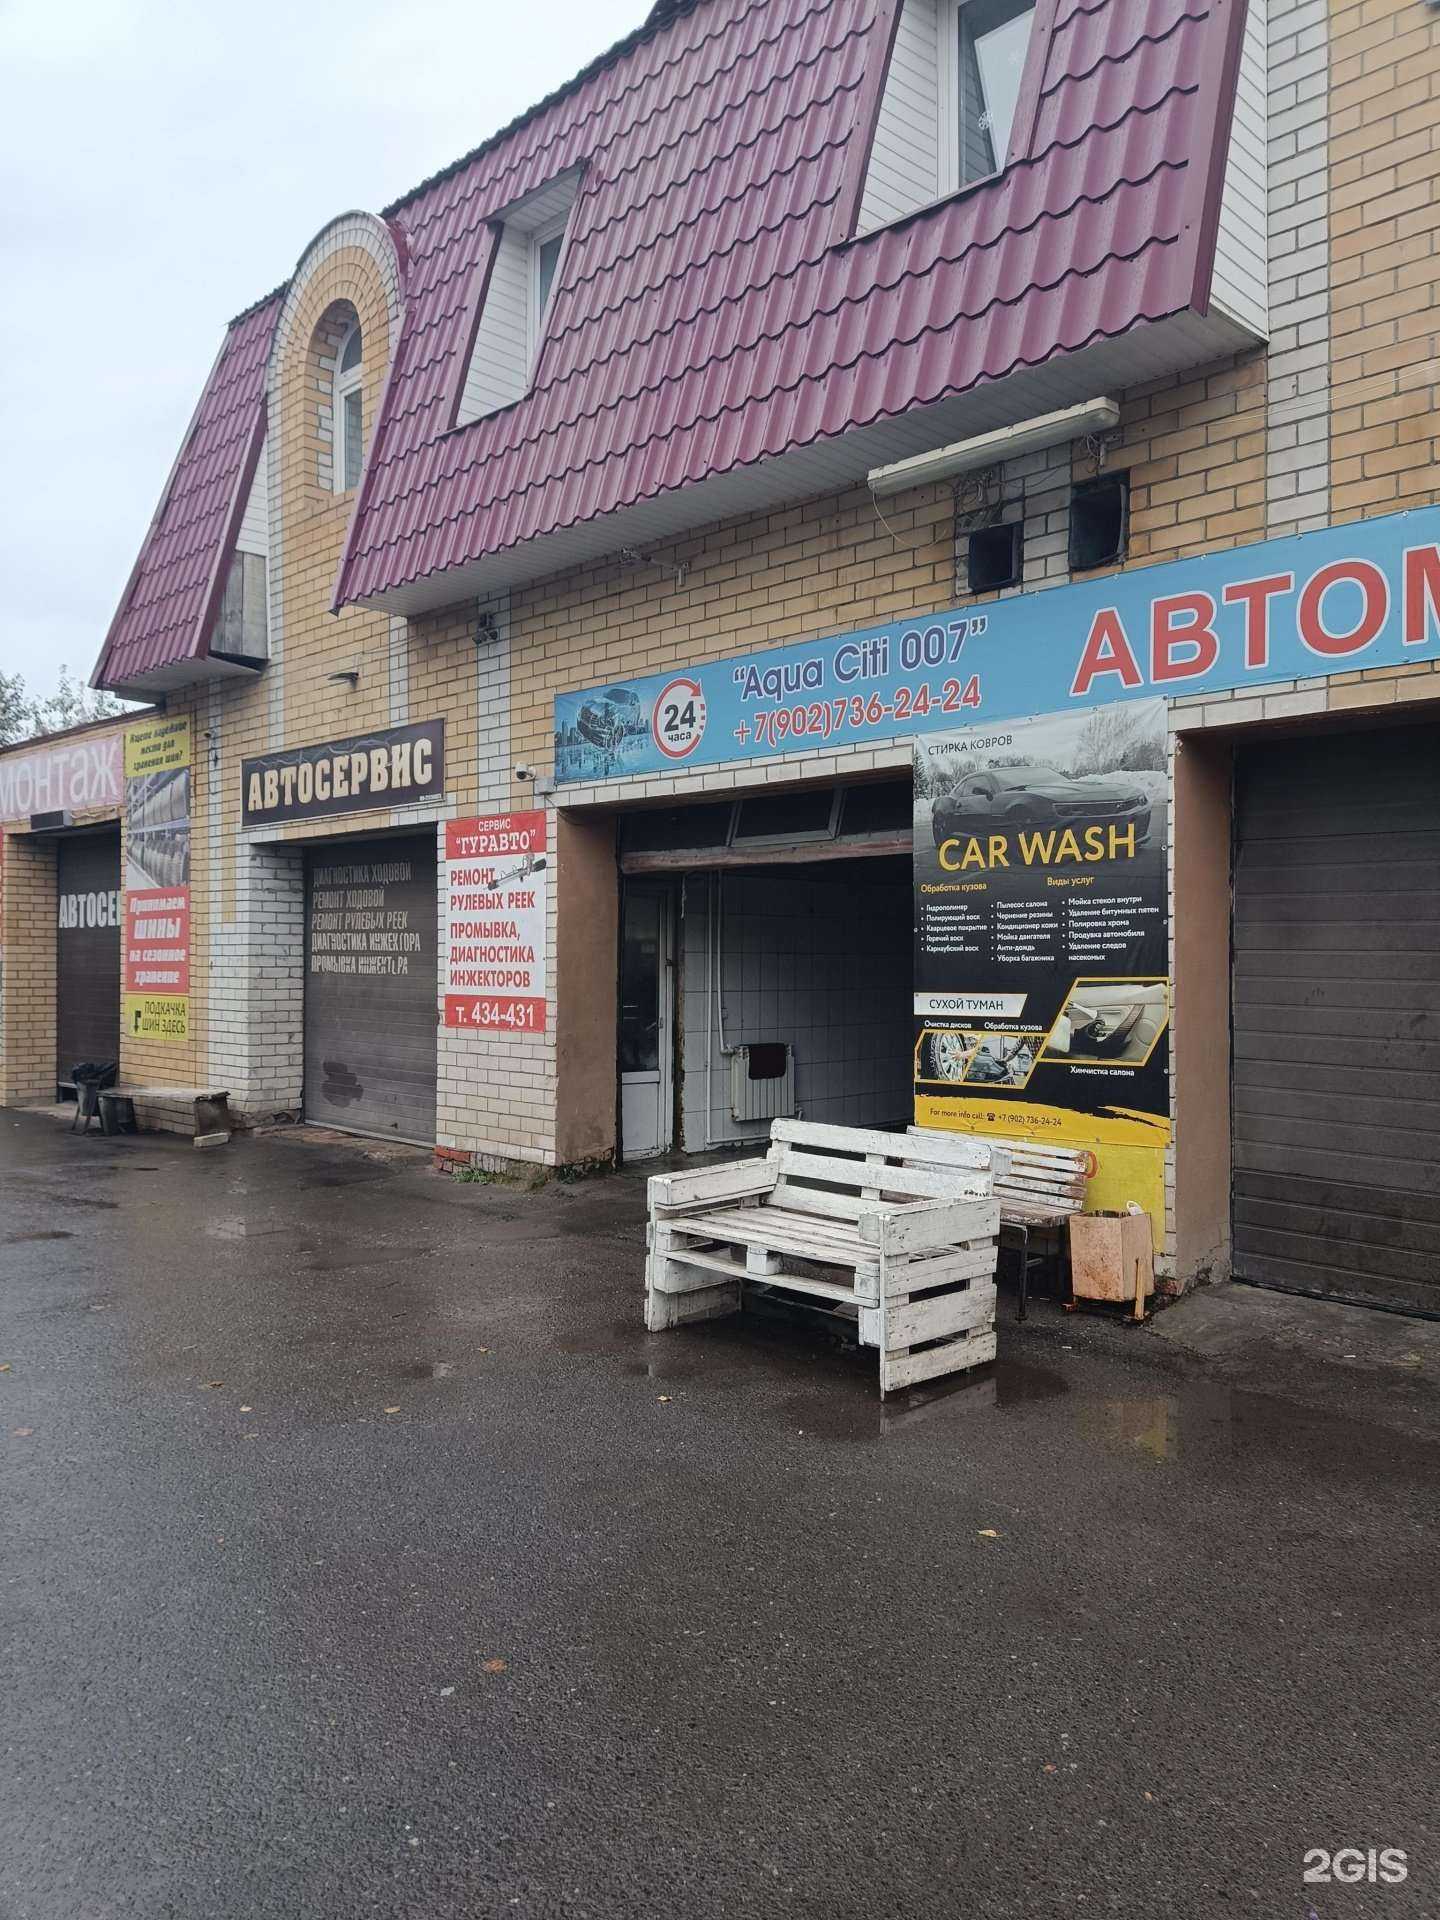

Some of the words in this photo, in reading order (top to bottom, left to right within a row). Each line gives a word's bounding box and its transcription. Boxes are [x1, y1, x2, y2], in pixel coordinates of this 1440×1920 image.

[834, 636, 889, 683] Citi
[664, 700, 696, 732] 24
[733, 674, 981, 747] +7(902)736-24-24
[668, 731, 692, 742] часа
[928, 740, 968, 756] СТИРКА
[970, 735, 1013, 750] КОВРОВ
[248, 738, 432, 812] АВТОСЕРВИС
[479, 818, 511, 831] СЕРВИС
[938, 835, 1010, 871] CAR
[1018, 823, 1135, 866] WASH
[450, 868, 495, 887] РЕМОНТ
[1047, 877, 1069, 886] Виды
[1071, 876, 1095, 886] услуг
[921, 884, 960, 894] Обработка
[961, 883, 987, 892] кузова
[130, 897, 186, 915] Принимаем
[313, 891, 344, 909] РЕМОНТ
[450, 893, 503, 911] РУЛЕВЫХ
[508, 891, 535, 909] РЕЕК
[1068, 898, 1091, 906] Мойка
[1117, 896, 1142, 904] внутри
[926, 904, 968, 912] Гидрополимер
[1068, 909, 1100, 918] Удаление
[1101, 907, 1137, 916] битумных
[312, 912, 343, 929] РЕМОНТ
[387, 910, 408, 929] РЕЕК
[926, 914, 965, 922] Полирующий
[997, 912, 1028, 920] Чернение
[450, 921, 520, 940] ПРОМЫВКА,
[926, 925, 957, 933] Кварцевое
[997, 923, 1040, 931] Кондиционер
[1068, 920, 1106, 929] Полировка
[926, 935, 949, 943] Горячий
[1068, 931, 1101, 940] Продувка
[1102, 929, 1145, 938] автомобиля
[312, 932, 367, 953] ДИАГНОСТИКА
[926, 945, 964, 953] Карнаубский
[997, 944, 1036, 952] Анти-дождь
[1068, 942, 1100, 950] Удаление
[129, 950, 141, 962] на
[143, 949, 186, 962] сезонное
[450, 946, 535, 965] ДИАГНОСТИКА
[997, 954, 1020, 963] Уборка
[134, 971, 180, 986] хранение
[450, 970, 531, 987] ИНЖЕКТОРОВ
[144, 1001, 186, 1016] ПОДКАЧКА
[929, 998, 964, 1009] СУХОЙ
[967, 1000, 1004, 1010] ТУМАН
[472, 1002, 534, 1027] 434-431
[142, 1017, 160, 1031] ШИН
[161, 1019, 186, 1033] ЗДЕСЬ
[924, 1020, 949, 1028] Очистка
[984, 1021, 1019, 1031] Обработка
[1070, 1066, 1108, 1075] Химчистка
[1109, 1068, 1135, 1076] салона
[930, 1108, 940, 1116] For
[958, 1109, 971, 1118] info
[971, 1111, 985, 1120] call:
[1007, 1114, 1025, 1124] (902)
[1026, 1116, 1062, 1127] 736-24-24
